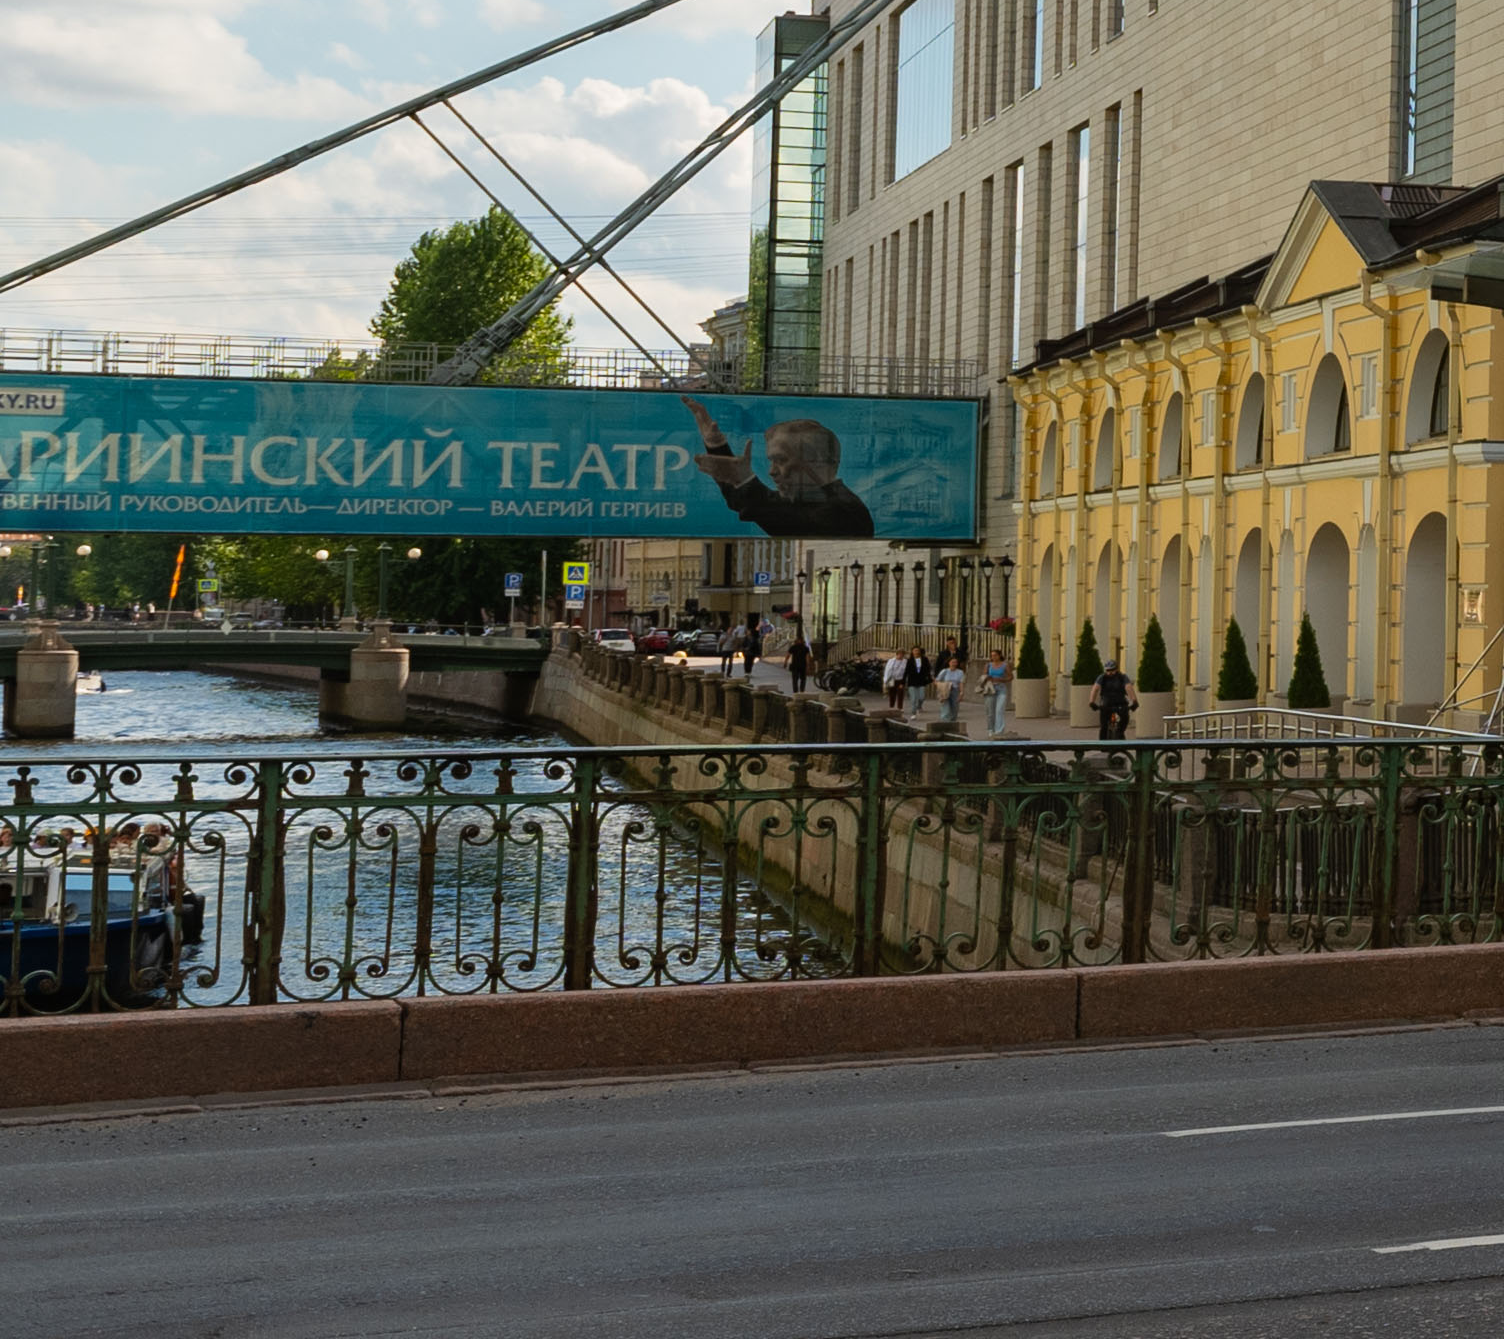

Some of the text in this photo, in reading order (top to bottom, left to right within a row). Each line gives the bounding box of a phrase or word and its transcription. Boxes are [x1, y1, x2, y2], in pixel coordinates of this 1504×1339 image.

[0, 427, 690, 491] РИИНСКИЙ ТЕАТР
[0, 491, 112, 511] ВЕННЫЙ
[490, 498, 593, 518] ВАЛЕРИЙ
[600, 501, 687, 518] ГЕРГИЕВ
